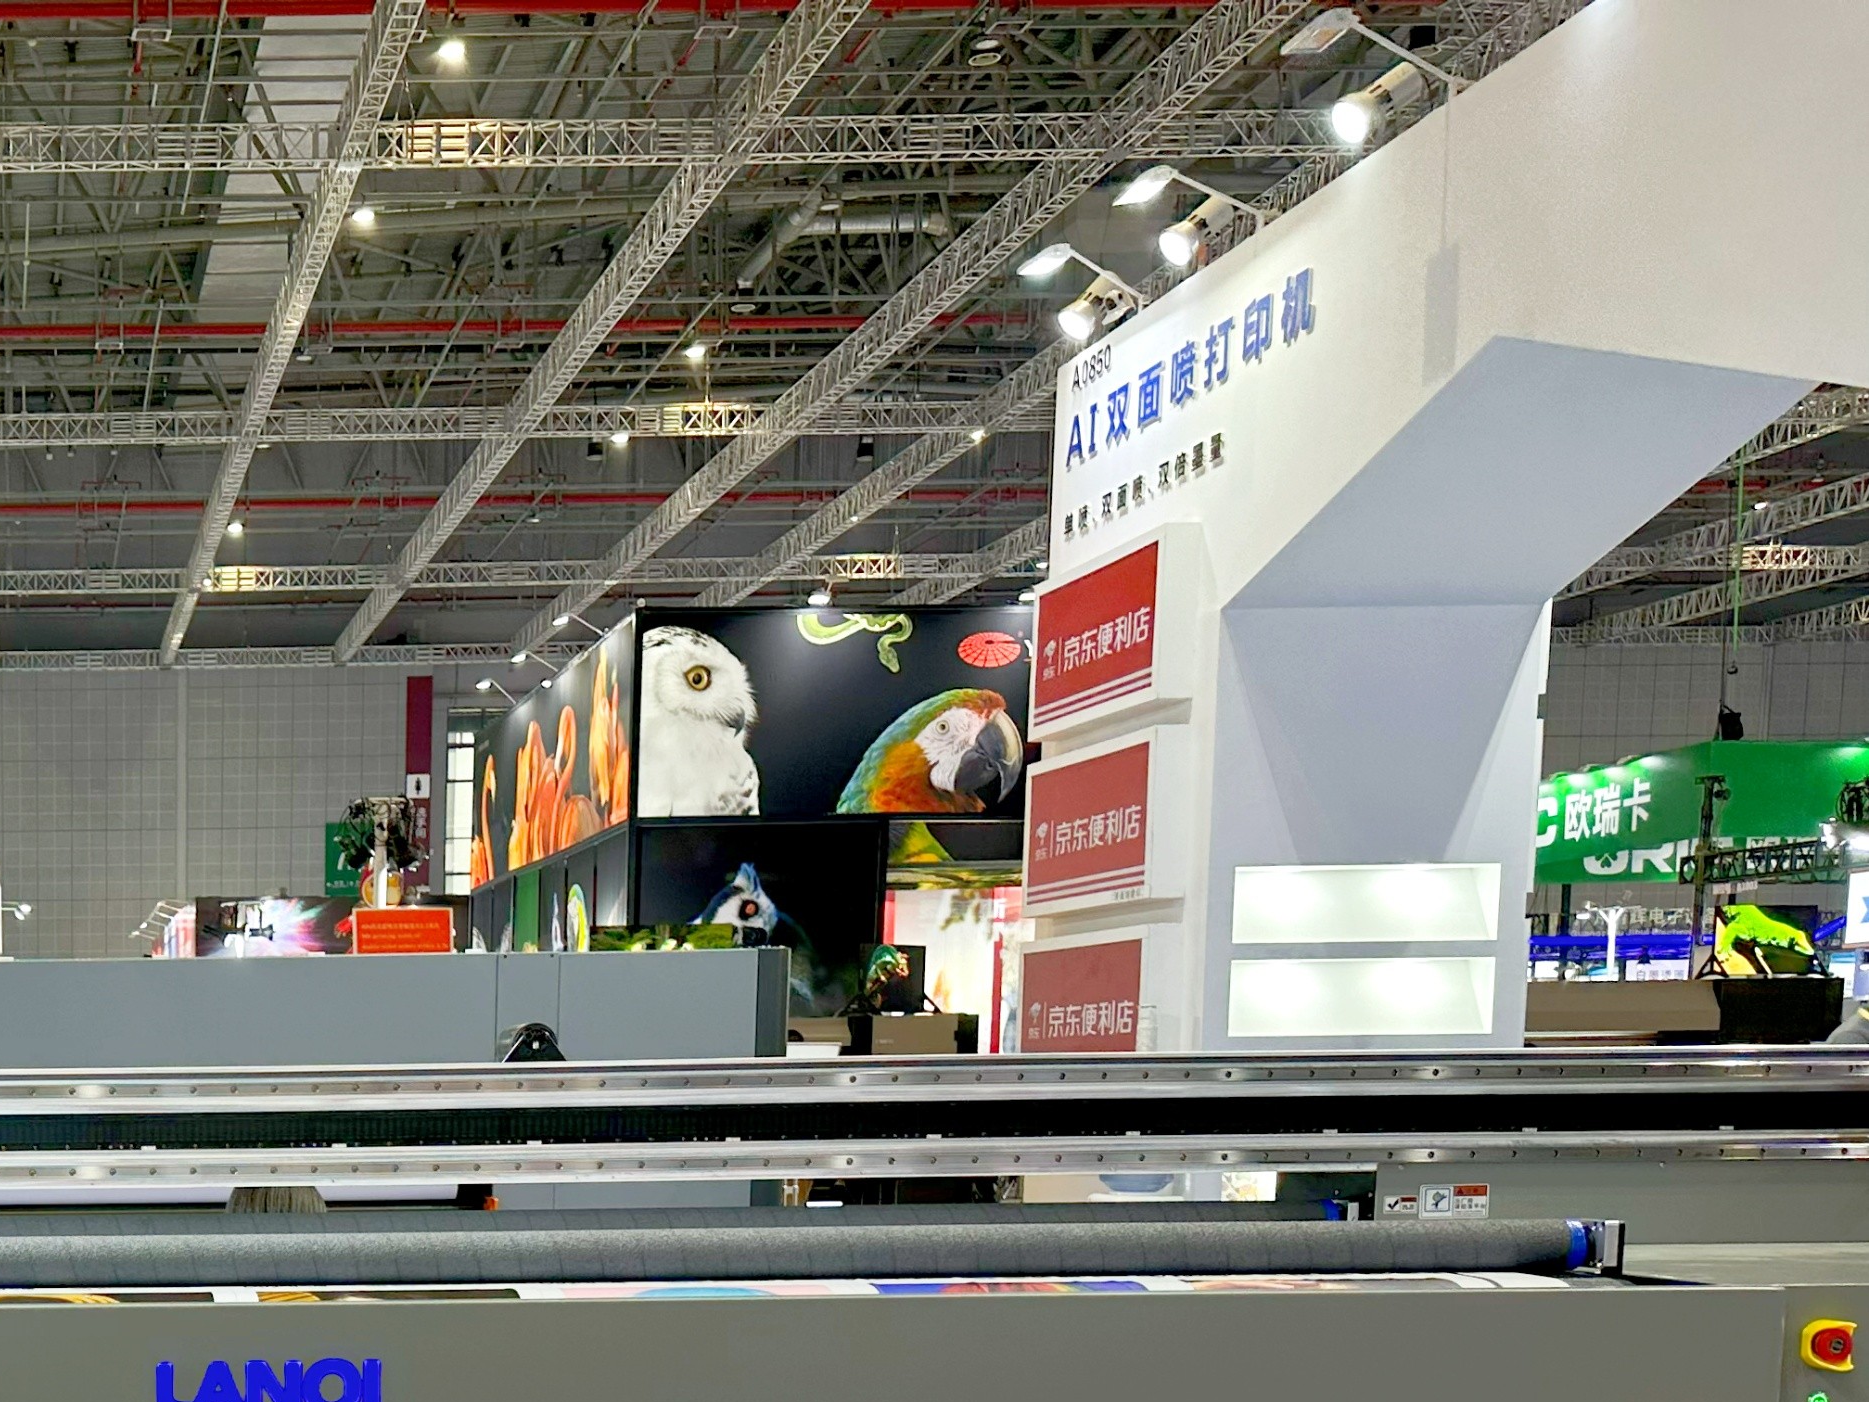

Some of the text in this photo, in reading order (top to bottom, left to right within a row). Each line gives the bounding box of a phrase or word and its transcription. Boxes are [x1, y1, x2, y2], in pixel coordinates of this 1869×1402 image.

[1071, 344, 1111, 392] A0850
[1063, 607, 1151, 673] 京东便利店
[1054, 805, 1143, 856] 京东便利店
[1563, 777, 1652, 842] 欧瑞卡
[1047, 1001, 1134, 1038] 京东便利店
